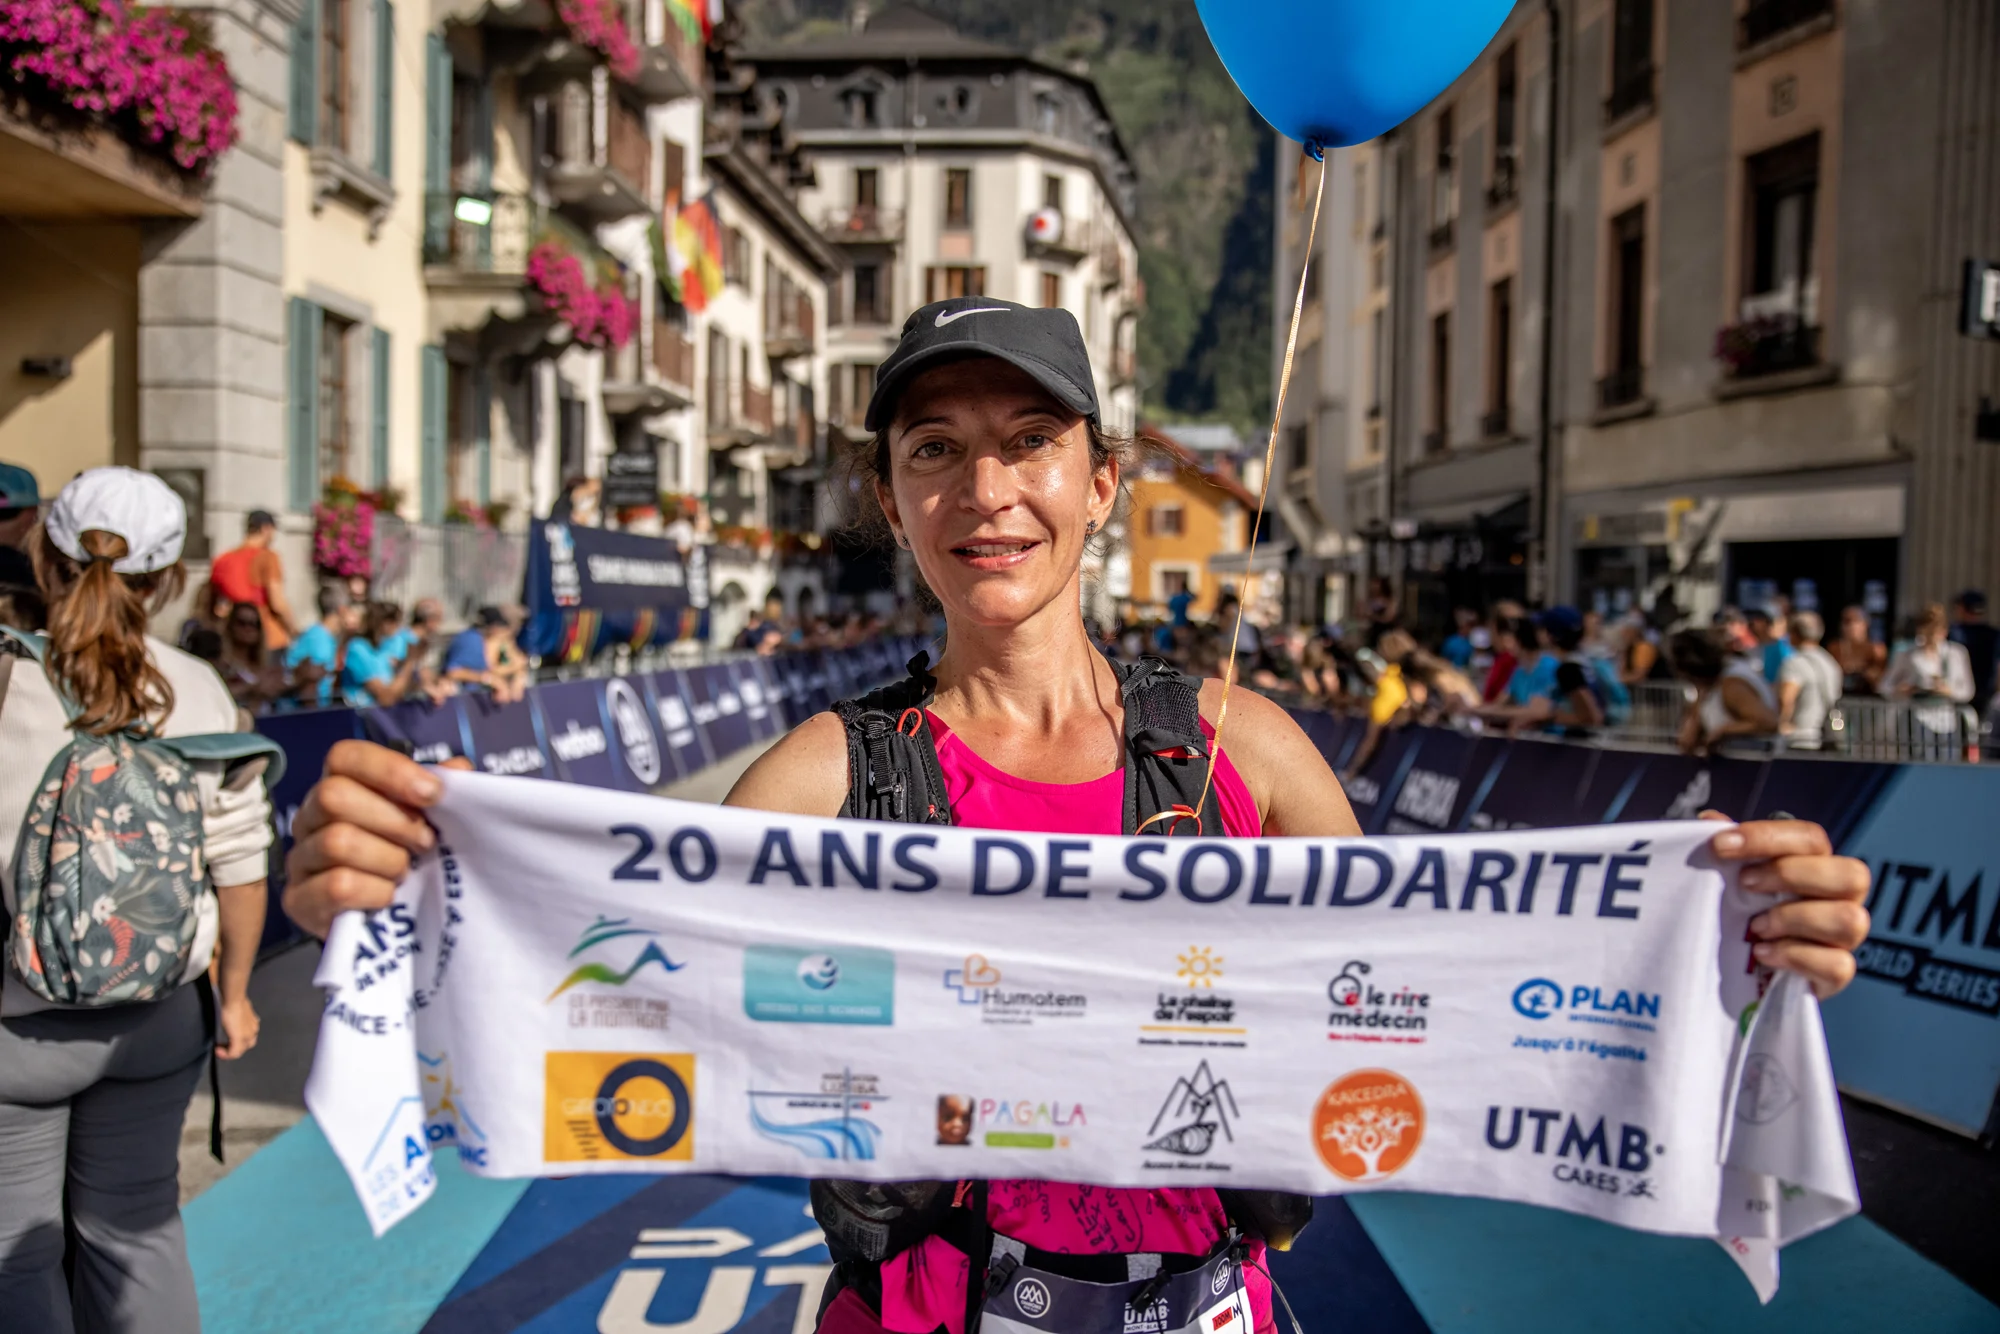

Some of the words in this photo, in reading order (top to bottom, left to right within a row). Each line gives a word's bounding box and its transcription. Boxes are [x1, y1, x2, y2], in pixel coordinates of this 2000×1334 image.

[609, 824, 719, 883] 20
[748, 827, 940, 894] ANS
[970, 836, 1092, 900] DE
[1118, 839, 1652, 920] SOLIDARITÉ
[1856, 943, 1915, 979] ORLD
[1915, 962, 2000, 1009] SERIES
[1365, 984, 1385, 1006] le
[1391, 985, 1430, 1008] rire
[1570, 984, 1661, 1019] PLAN
[979, 1099, 1088, 1127] PAGALA
[1485, 1106, 1652, 1173] UTMB
[1553, 1163, 1621, 1195] CARES
